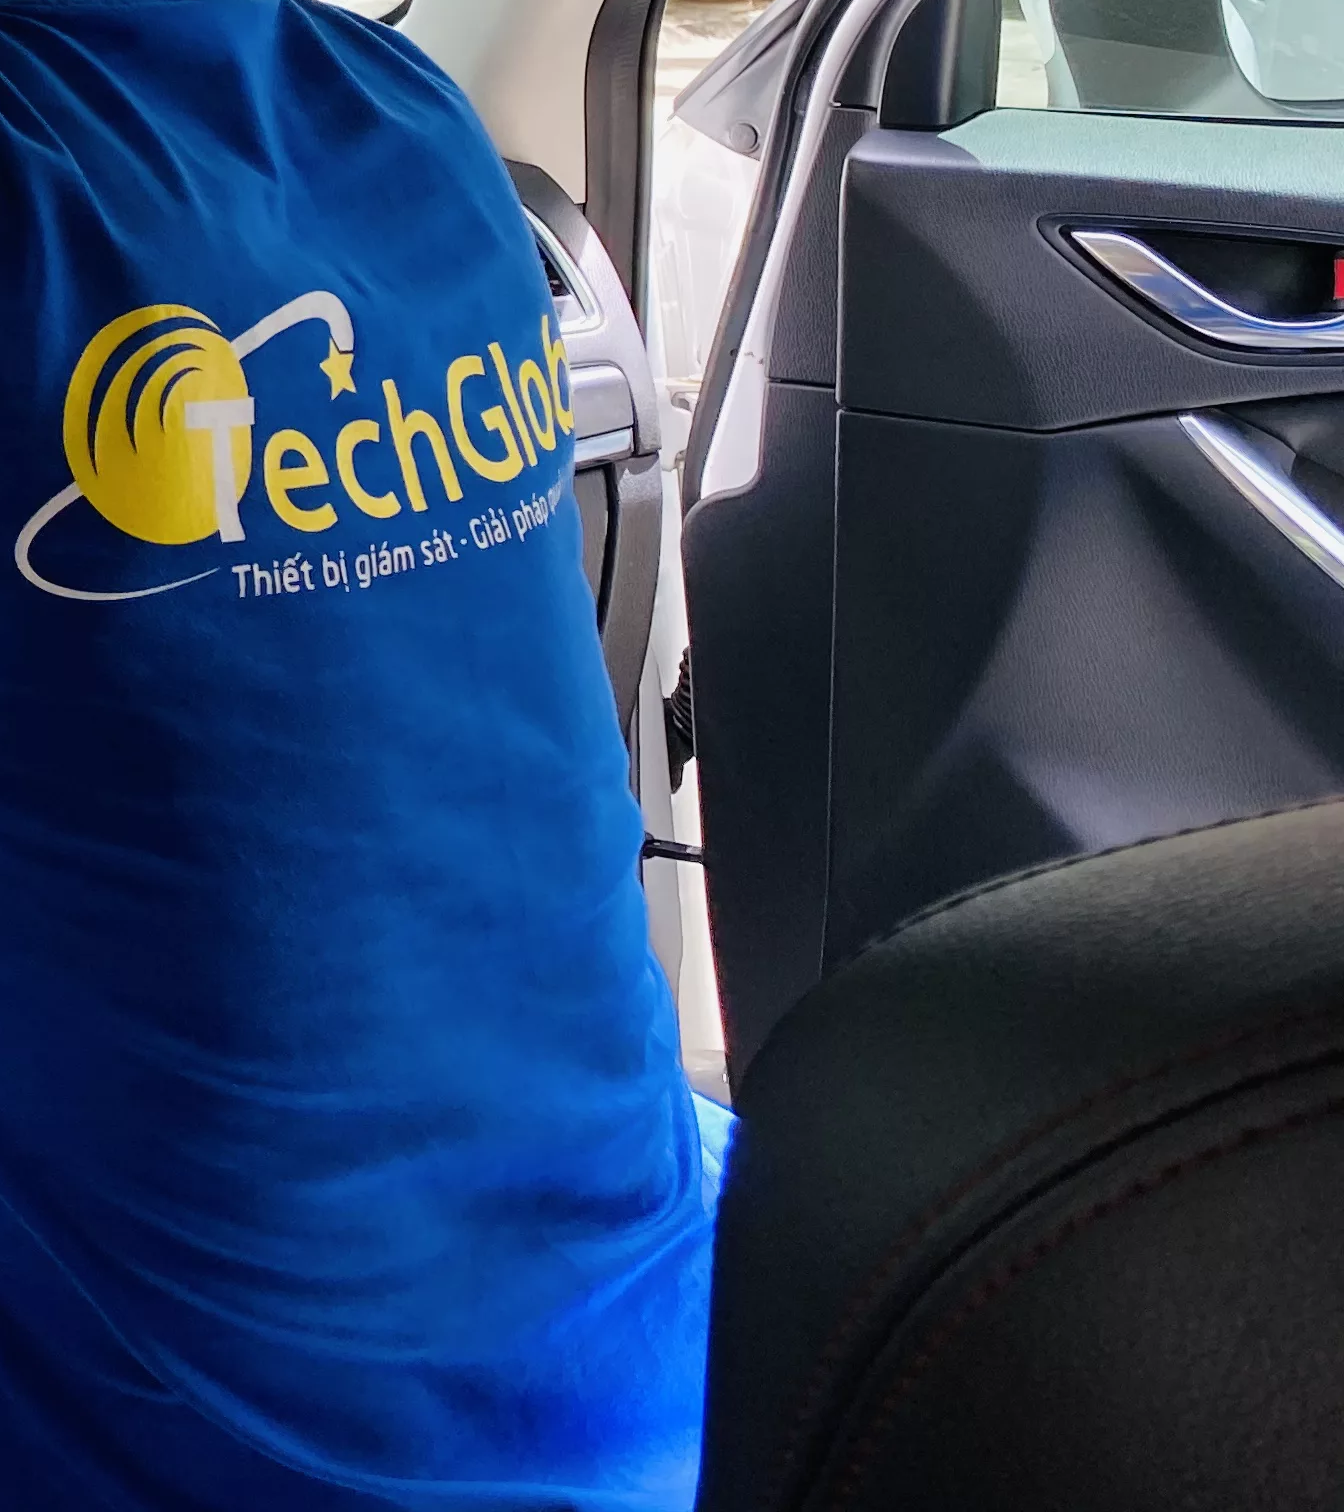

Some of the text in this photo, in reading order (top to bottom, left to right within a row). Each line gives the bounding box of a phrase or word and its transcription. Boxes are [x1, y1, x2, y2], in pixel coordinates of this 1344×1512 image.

[231, 551, 316, 599] Thiết
[321, 550, 351, 593] bị
[355, 540, 416, 589] giám
[420, 528, 459, 566] sát
[469, 507, 512, 550] Giải
[512, 492, 549, 543] pháp
